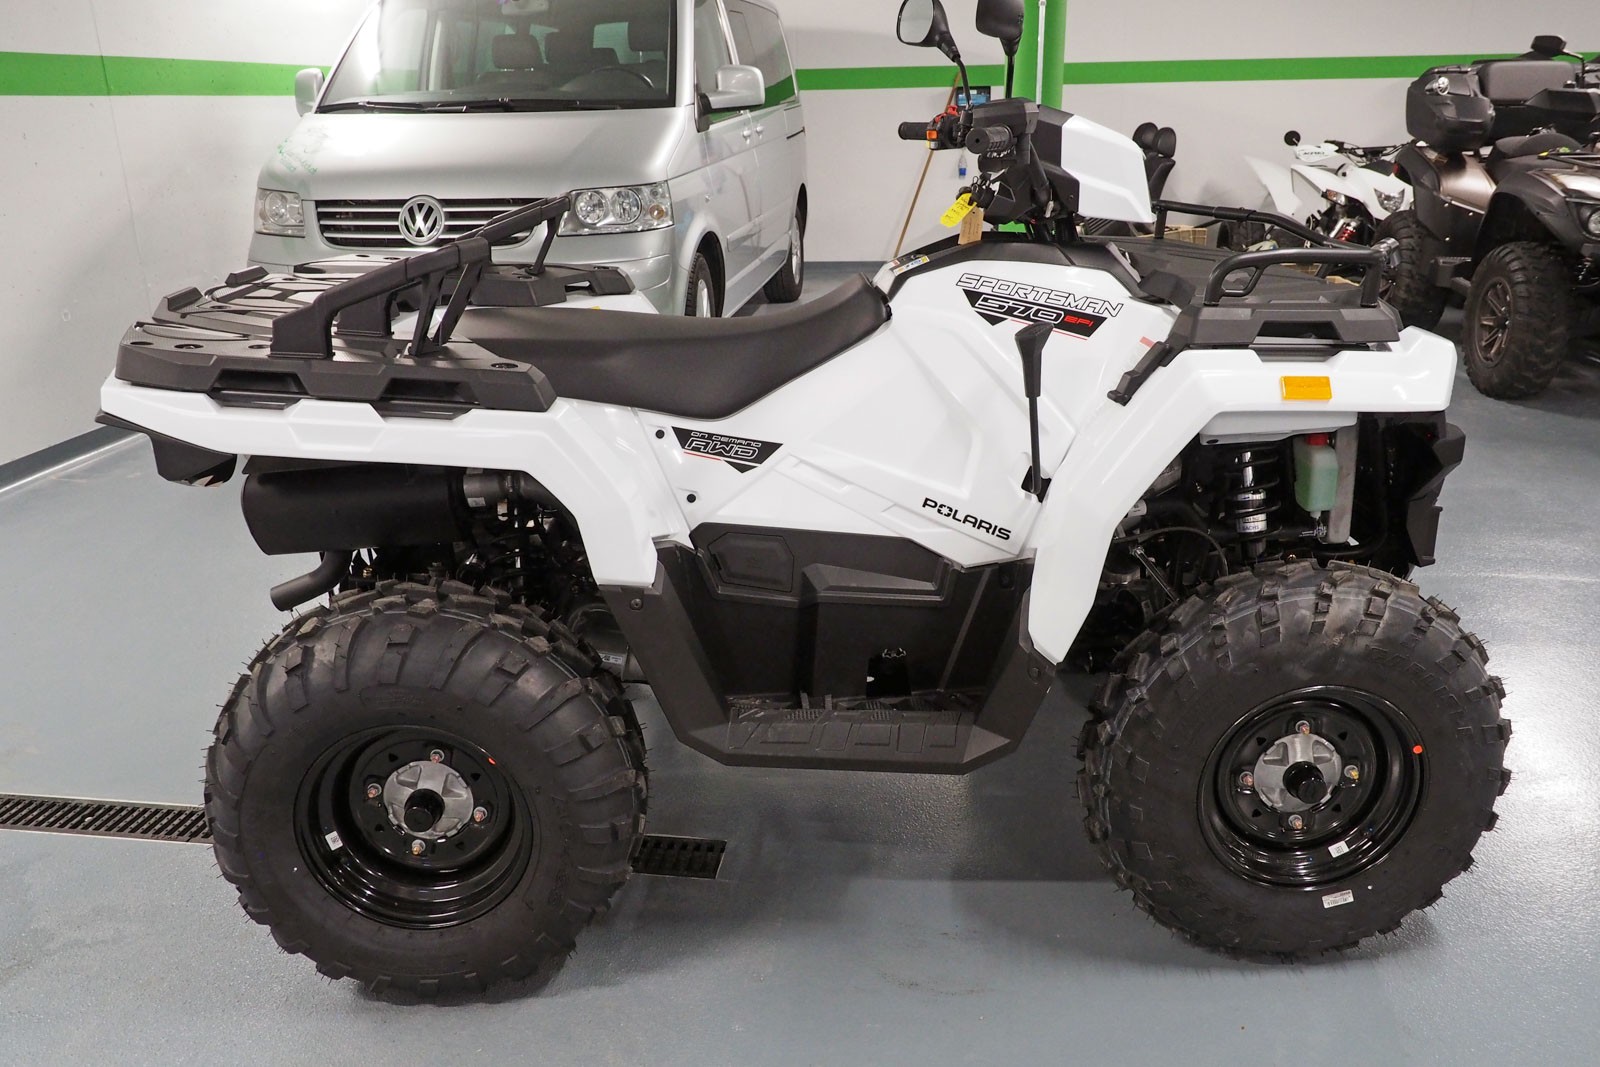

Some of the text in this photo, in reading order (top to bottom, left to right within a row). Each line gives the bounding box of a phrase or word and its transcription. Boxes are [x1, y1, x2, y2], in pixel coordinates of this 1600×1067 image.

[402, 199, 441, 242] VW
[956, 273, 1124, 317] SPORTSMAN
[974, 294, 1065, 325] 570
[685, 437, 759, 460] AWD
[691, 431, 762, 448] ON DEMAND
[922, 497, 1012, 541] POLARIS
